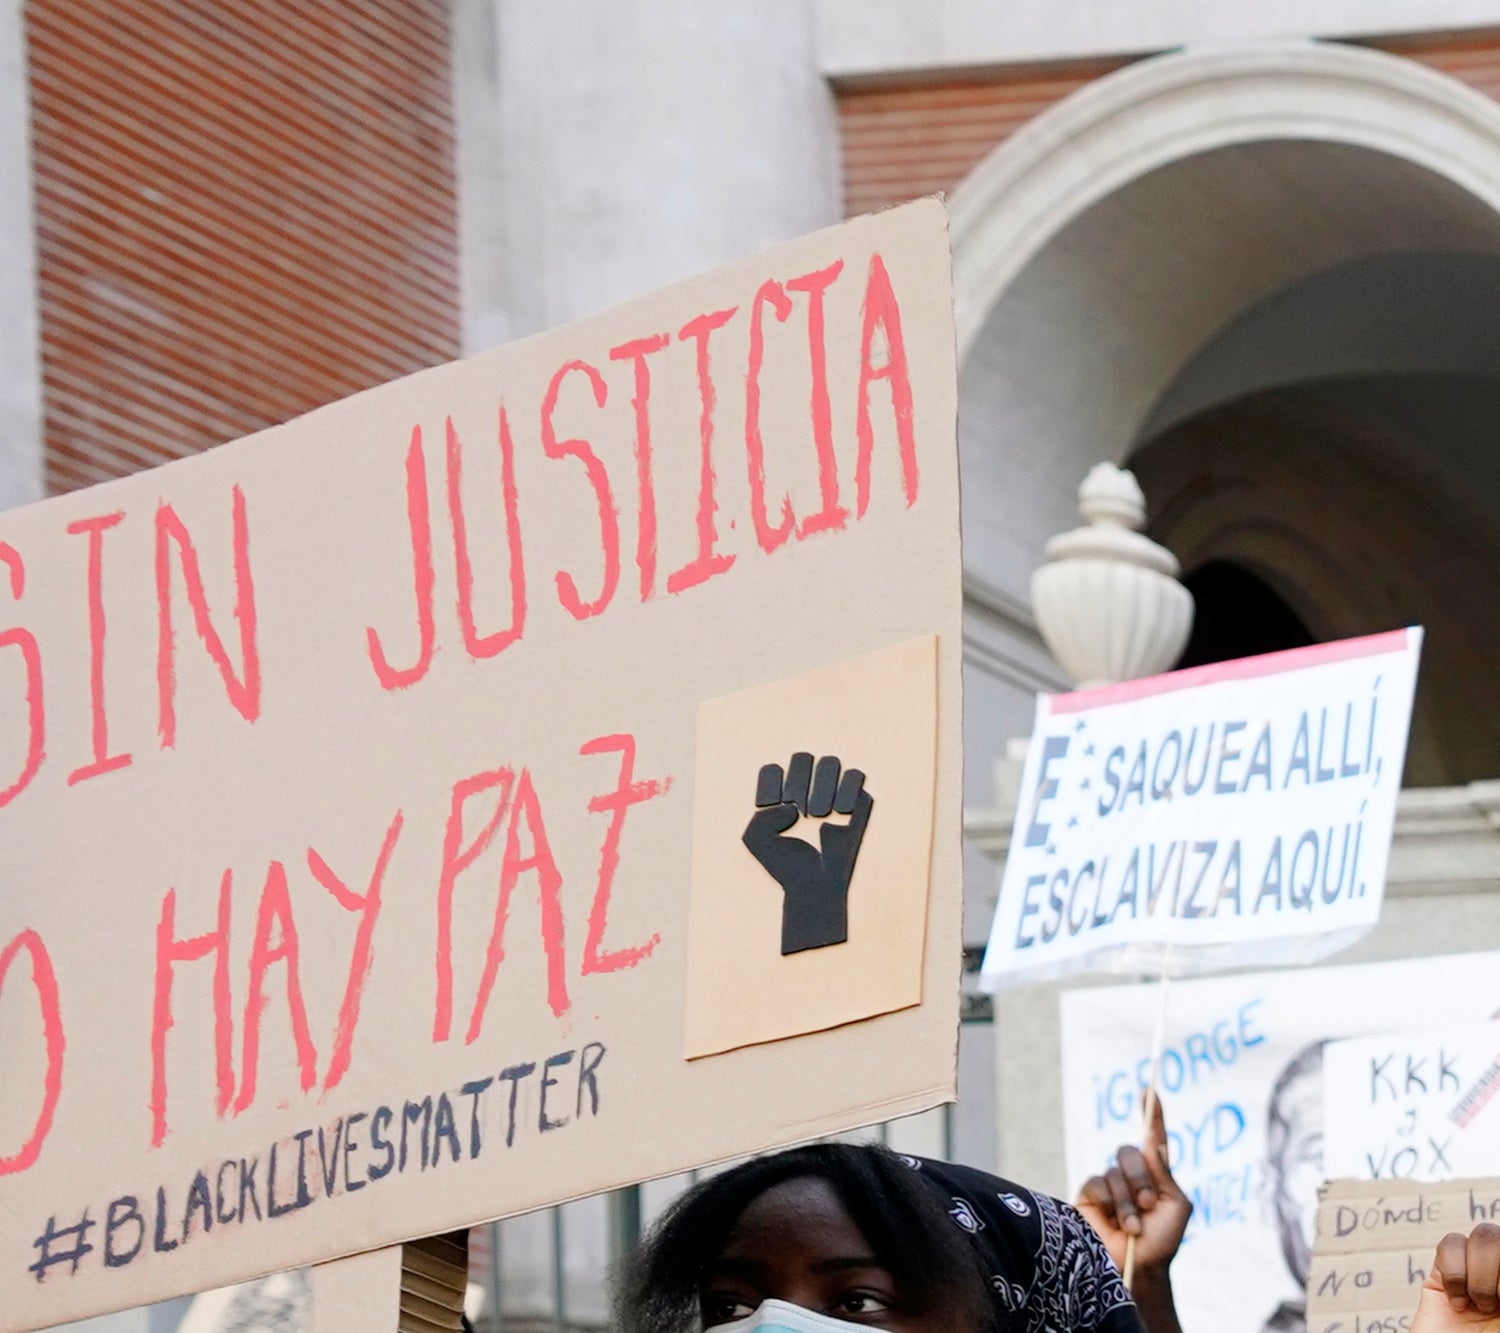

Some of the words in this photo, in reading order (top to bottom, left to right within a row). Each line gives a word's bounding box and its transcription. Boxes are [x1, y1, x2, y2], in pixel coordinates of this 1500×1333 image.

[366, 252, 922, 691] JUSTICIA
[1096, 717, 1273, 819] SAQUEA
[1013, 838, 1244, 951] ESCLAVIZA
[0, 928, 65, 1177] O
[148, 808, 404, 1151] HAY
[432, 734, 674, 1047] PAZ
[1369, 1047, 1462, 1102] KKK
[33, 1041, 607, 1284] #BLACKLIVESMATTER
[1315, 1267, 1375, 1301] NO
